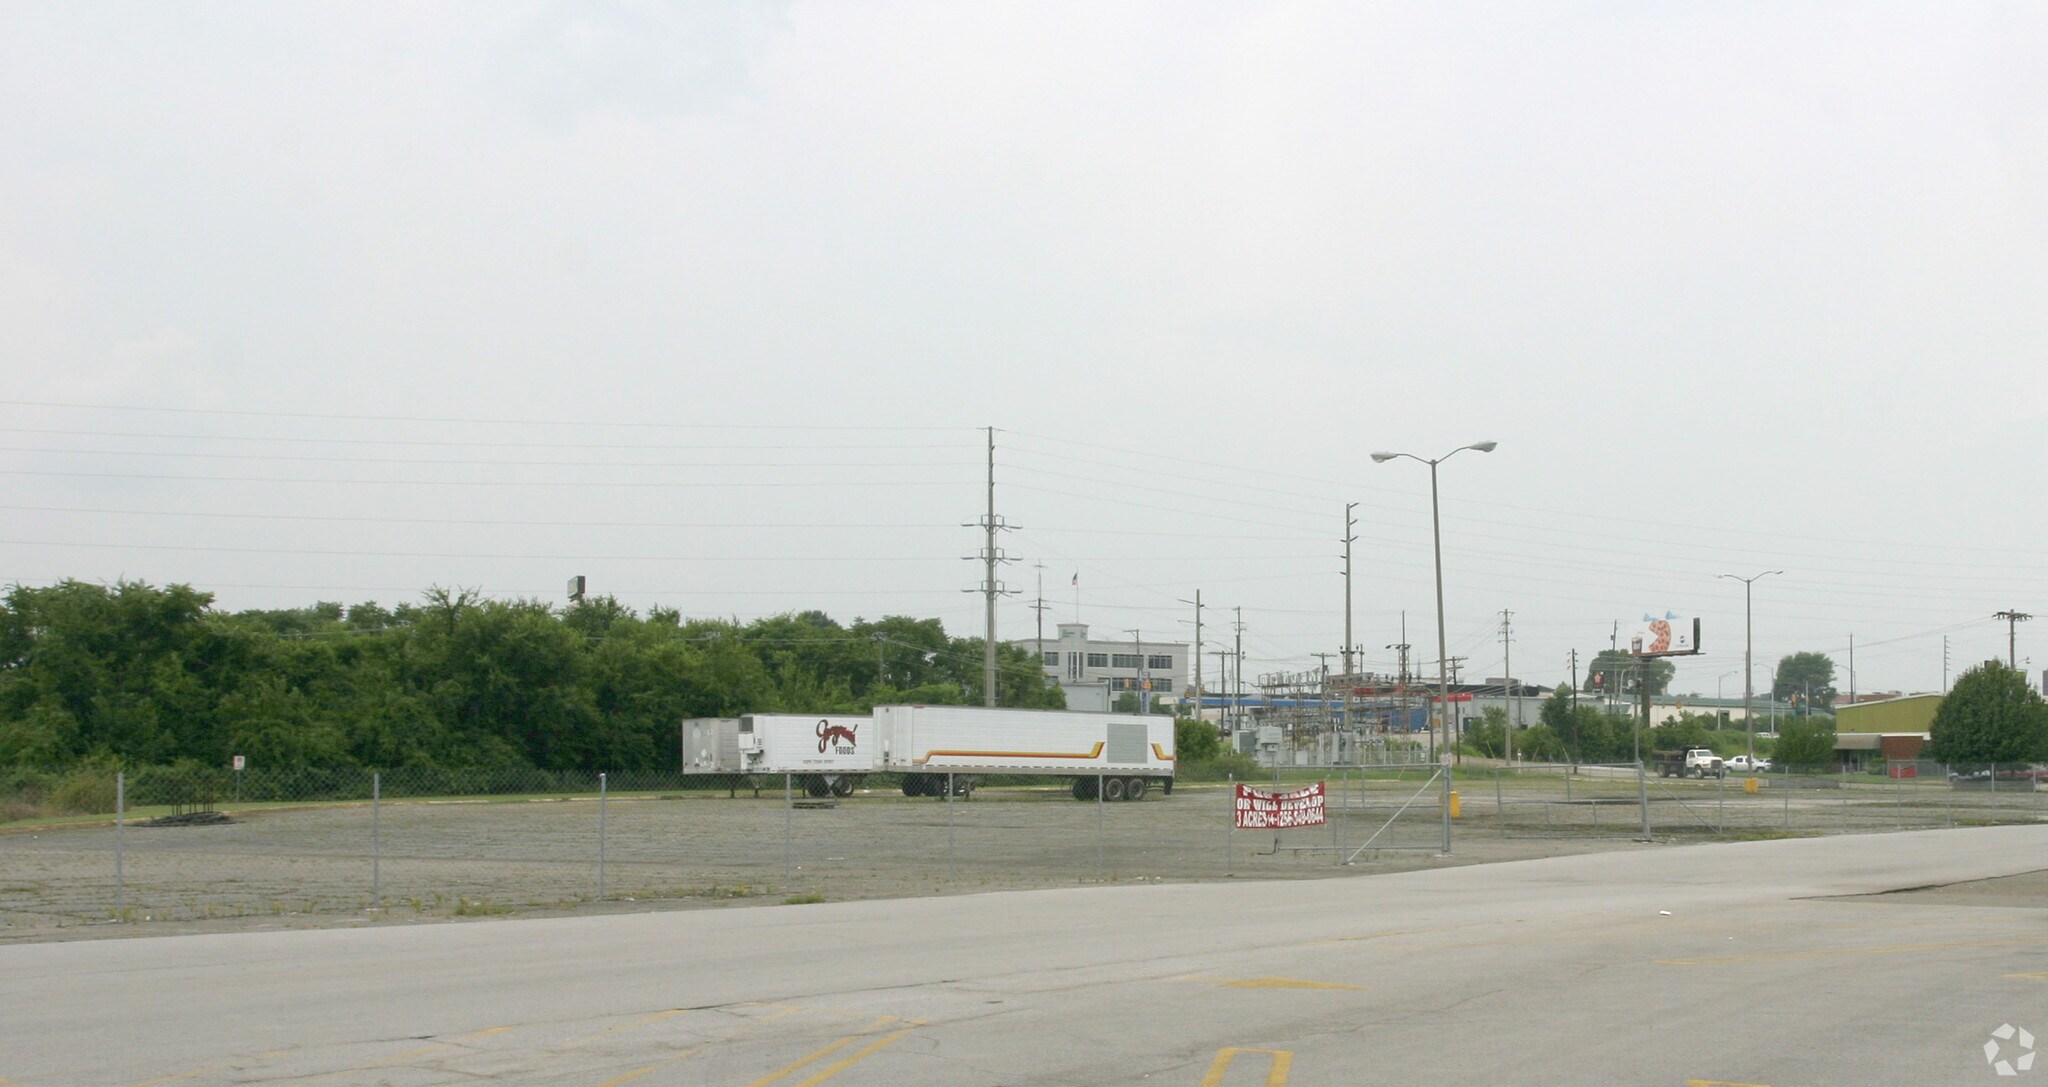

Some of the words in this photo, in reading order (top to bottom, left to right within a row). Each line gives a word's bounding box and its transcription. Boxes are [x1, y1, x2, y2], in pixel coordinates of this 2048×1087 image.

[835, 746, 855, 755] FOODS
[1237, 798, 1251, 810] OR
[1253, 799, 1279, 811] WILL
[1280, 795, 1324, 811] DEVELOP
[1237, 811, 1242, 827] 3
[1243, 811, 1267, 827] ACRES
